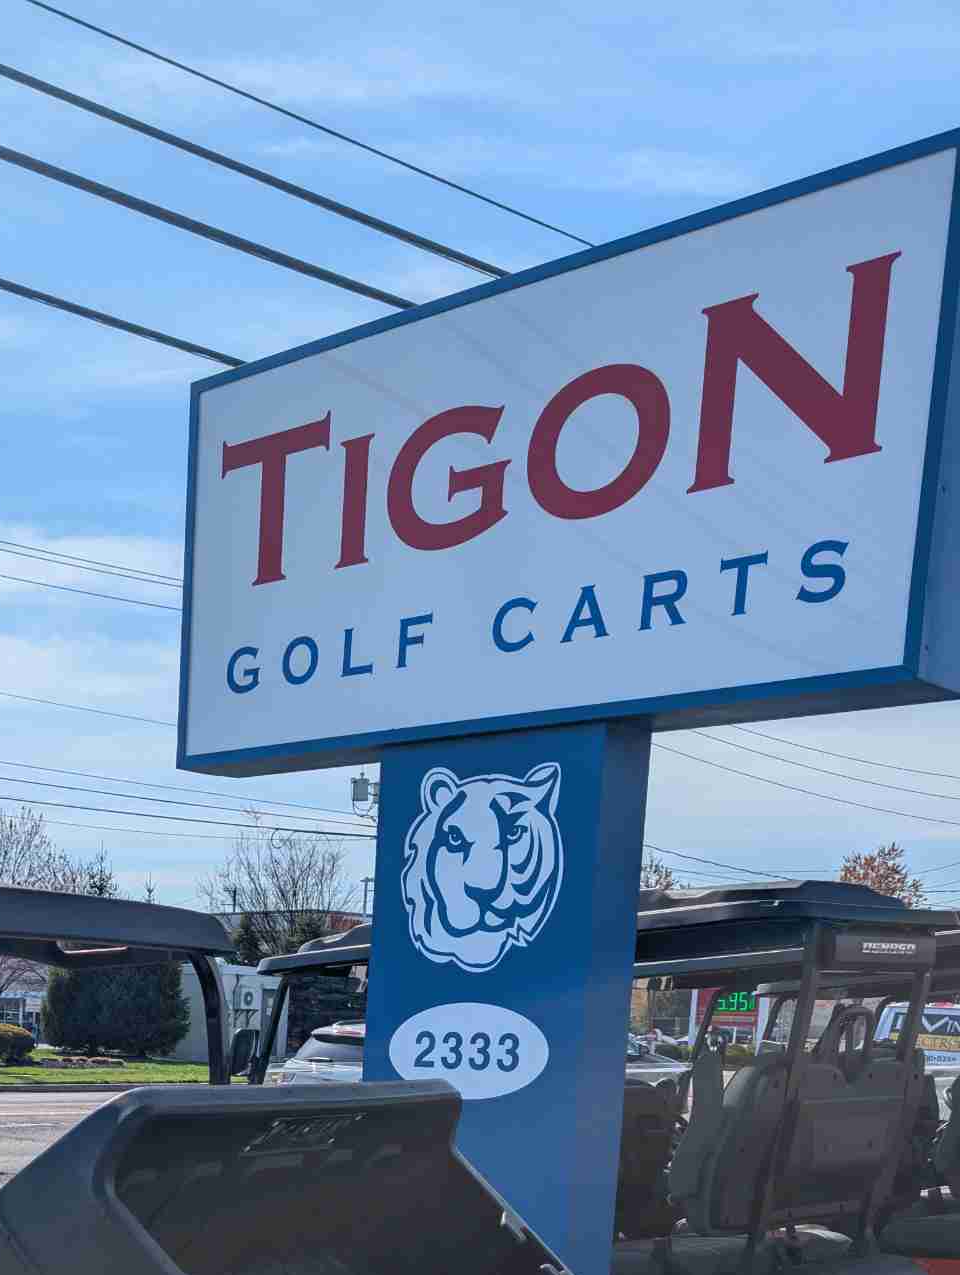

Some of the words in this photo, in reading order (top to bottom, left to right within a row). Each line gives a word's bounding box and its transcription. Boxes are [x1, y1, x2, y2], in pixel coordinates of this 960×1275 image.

[221, 250, 902, 587] TIGON
[226, 612, 434, 694] GOLF
[491, 540, 849, 653] CARTS
[413, 1030, 520, 1073] 2333
